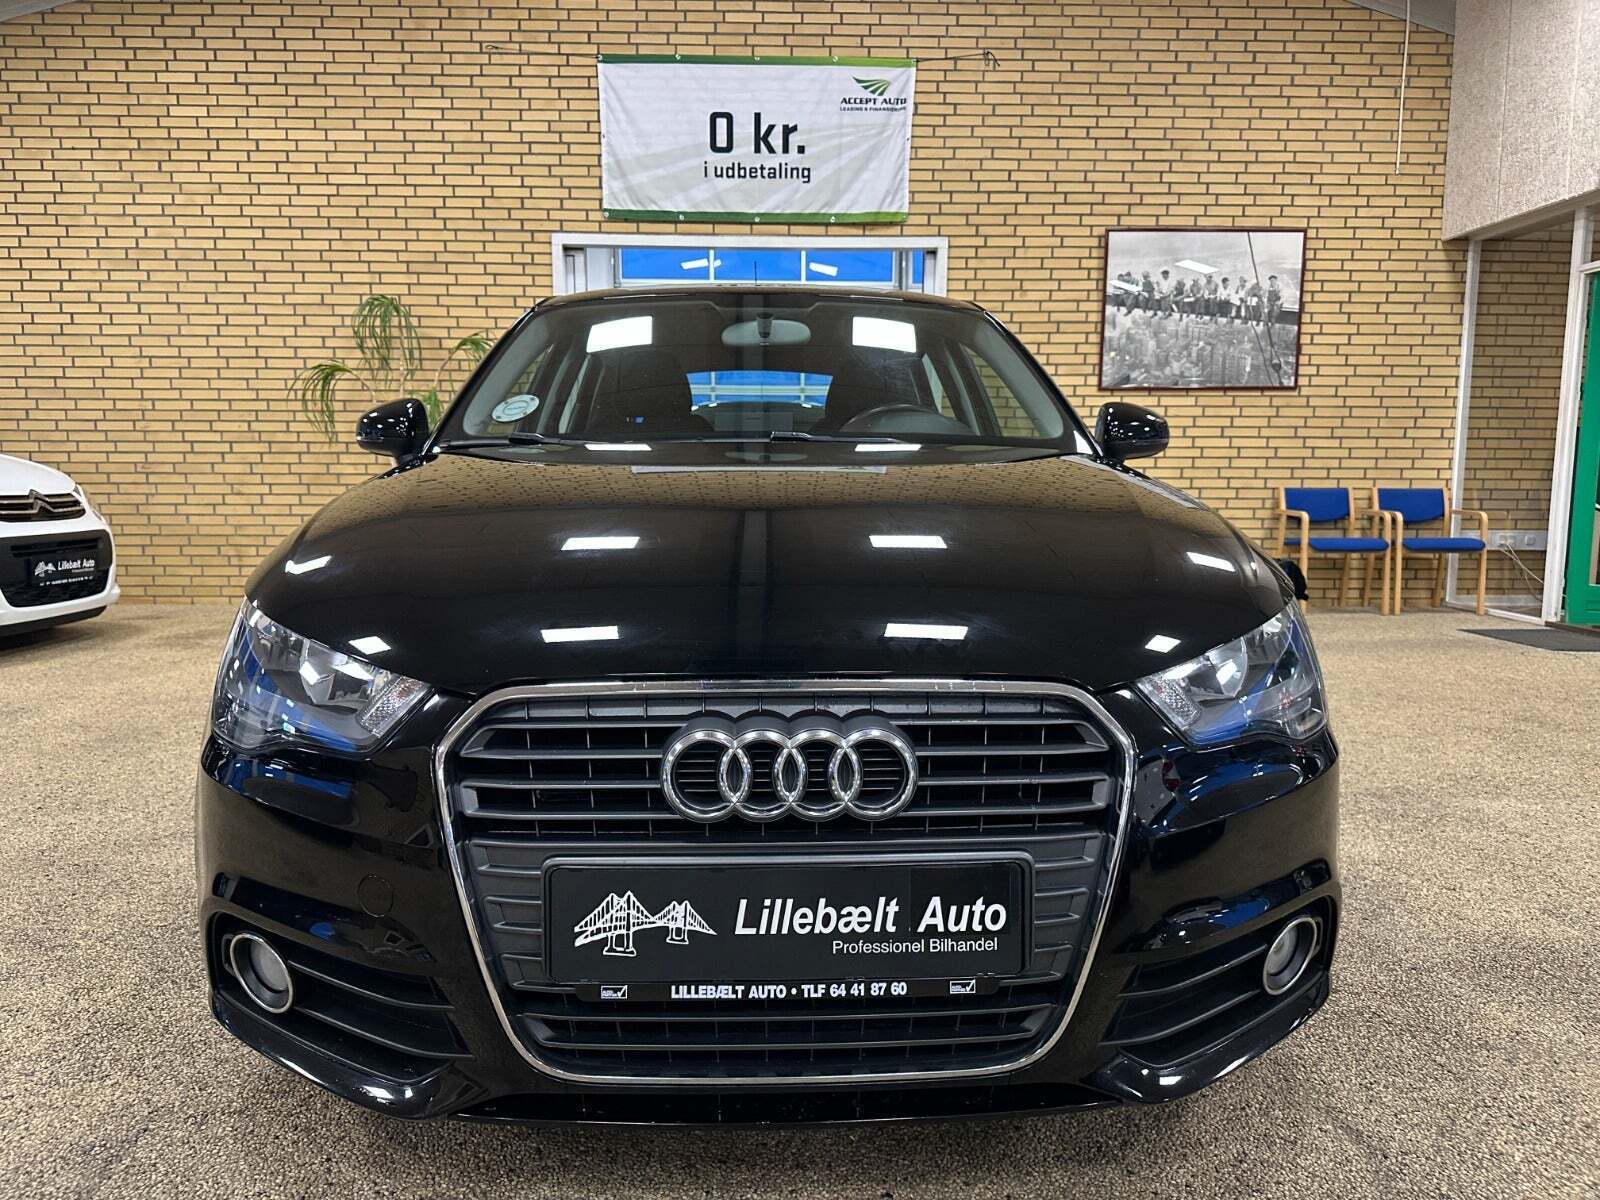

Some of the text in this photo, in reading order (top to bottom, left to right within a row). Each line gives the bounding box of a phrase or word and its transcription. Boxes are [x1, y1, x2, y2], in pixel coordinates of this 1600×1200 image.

[840, 97, 907, 105] ACCEPT AUTO
[709, 111, 806, 154] 0 kr.
[704, 161, 811, 184] i udbetaling
[734, 896, 1007, 935] Lillebælt Auto
[832, 937, 998, 954] Professionel Bilhandel
[670, 982, 908, 999] LILLEBÆLT AUTO TLF 64 41 87 60
